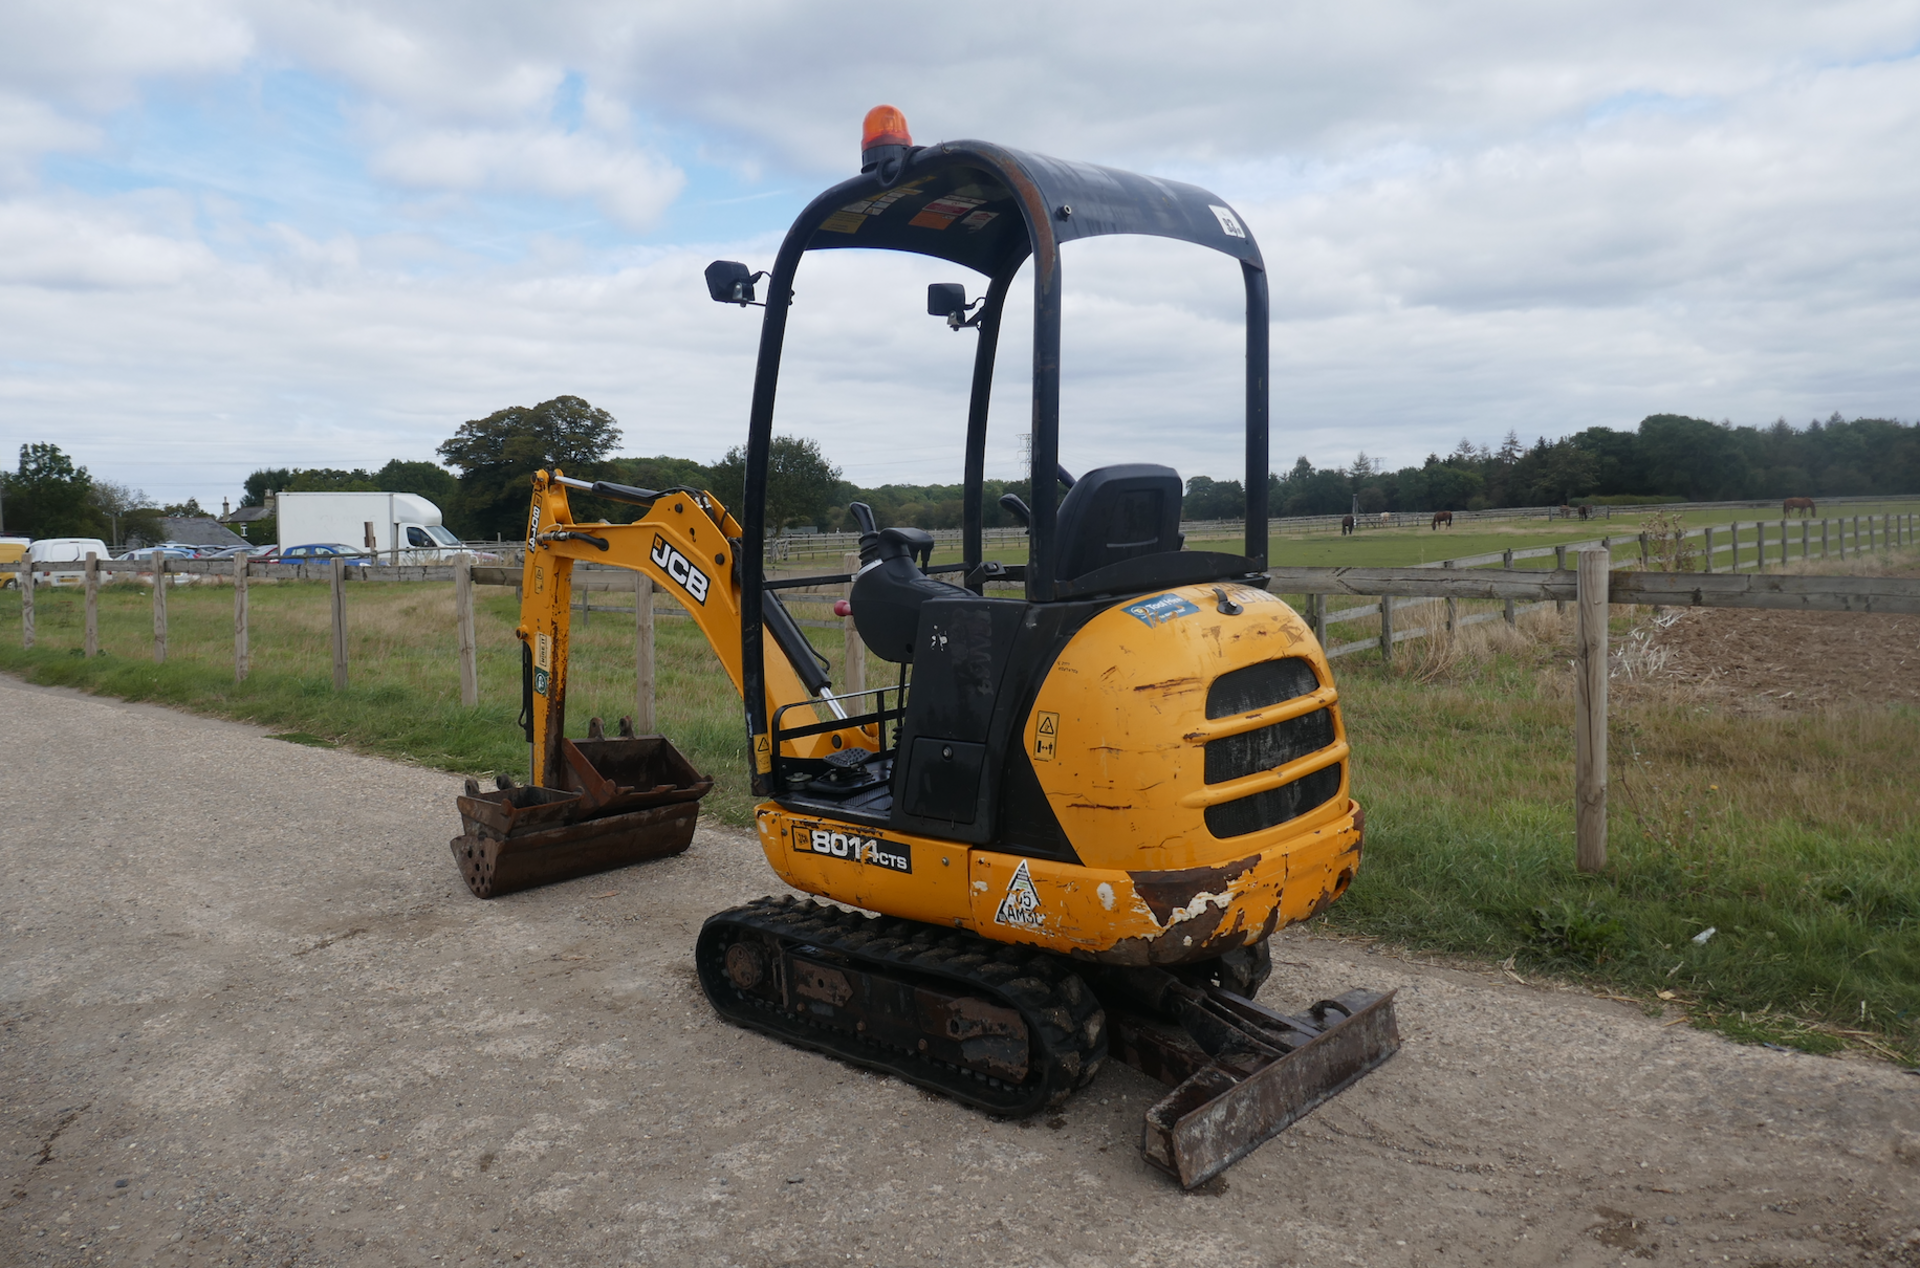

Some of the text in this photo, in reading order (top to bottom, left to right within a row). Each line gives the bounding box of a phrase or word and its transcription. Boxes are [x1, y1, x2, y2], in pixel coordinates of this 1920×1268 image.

[528, 506, 540, 553] 8014
[652, 543, 708, 602] JCB
[811, 830, 908, 870] 8014 CTS
